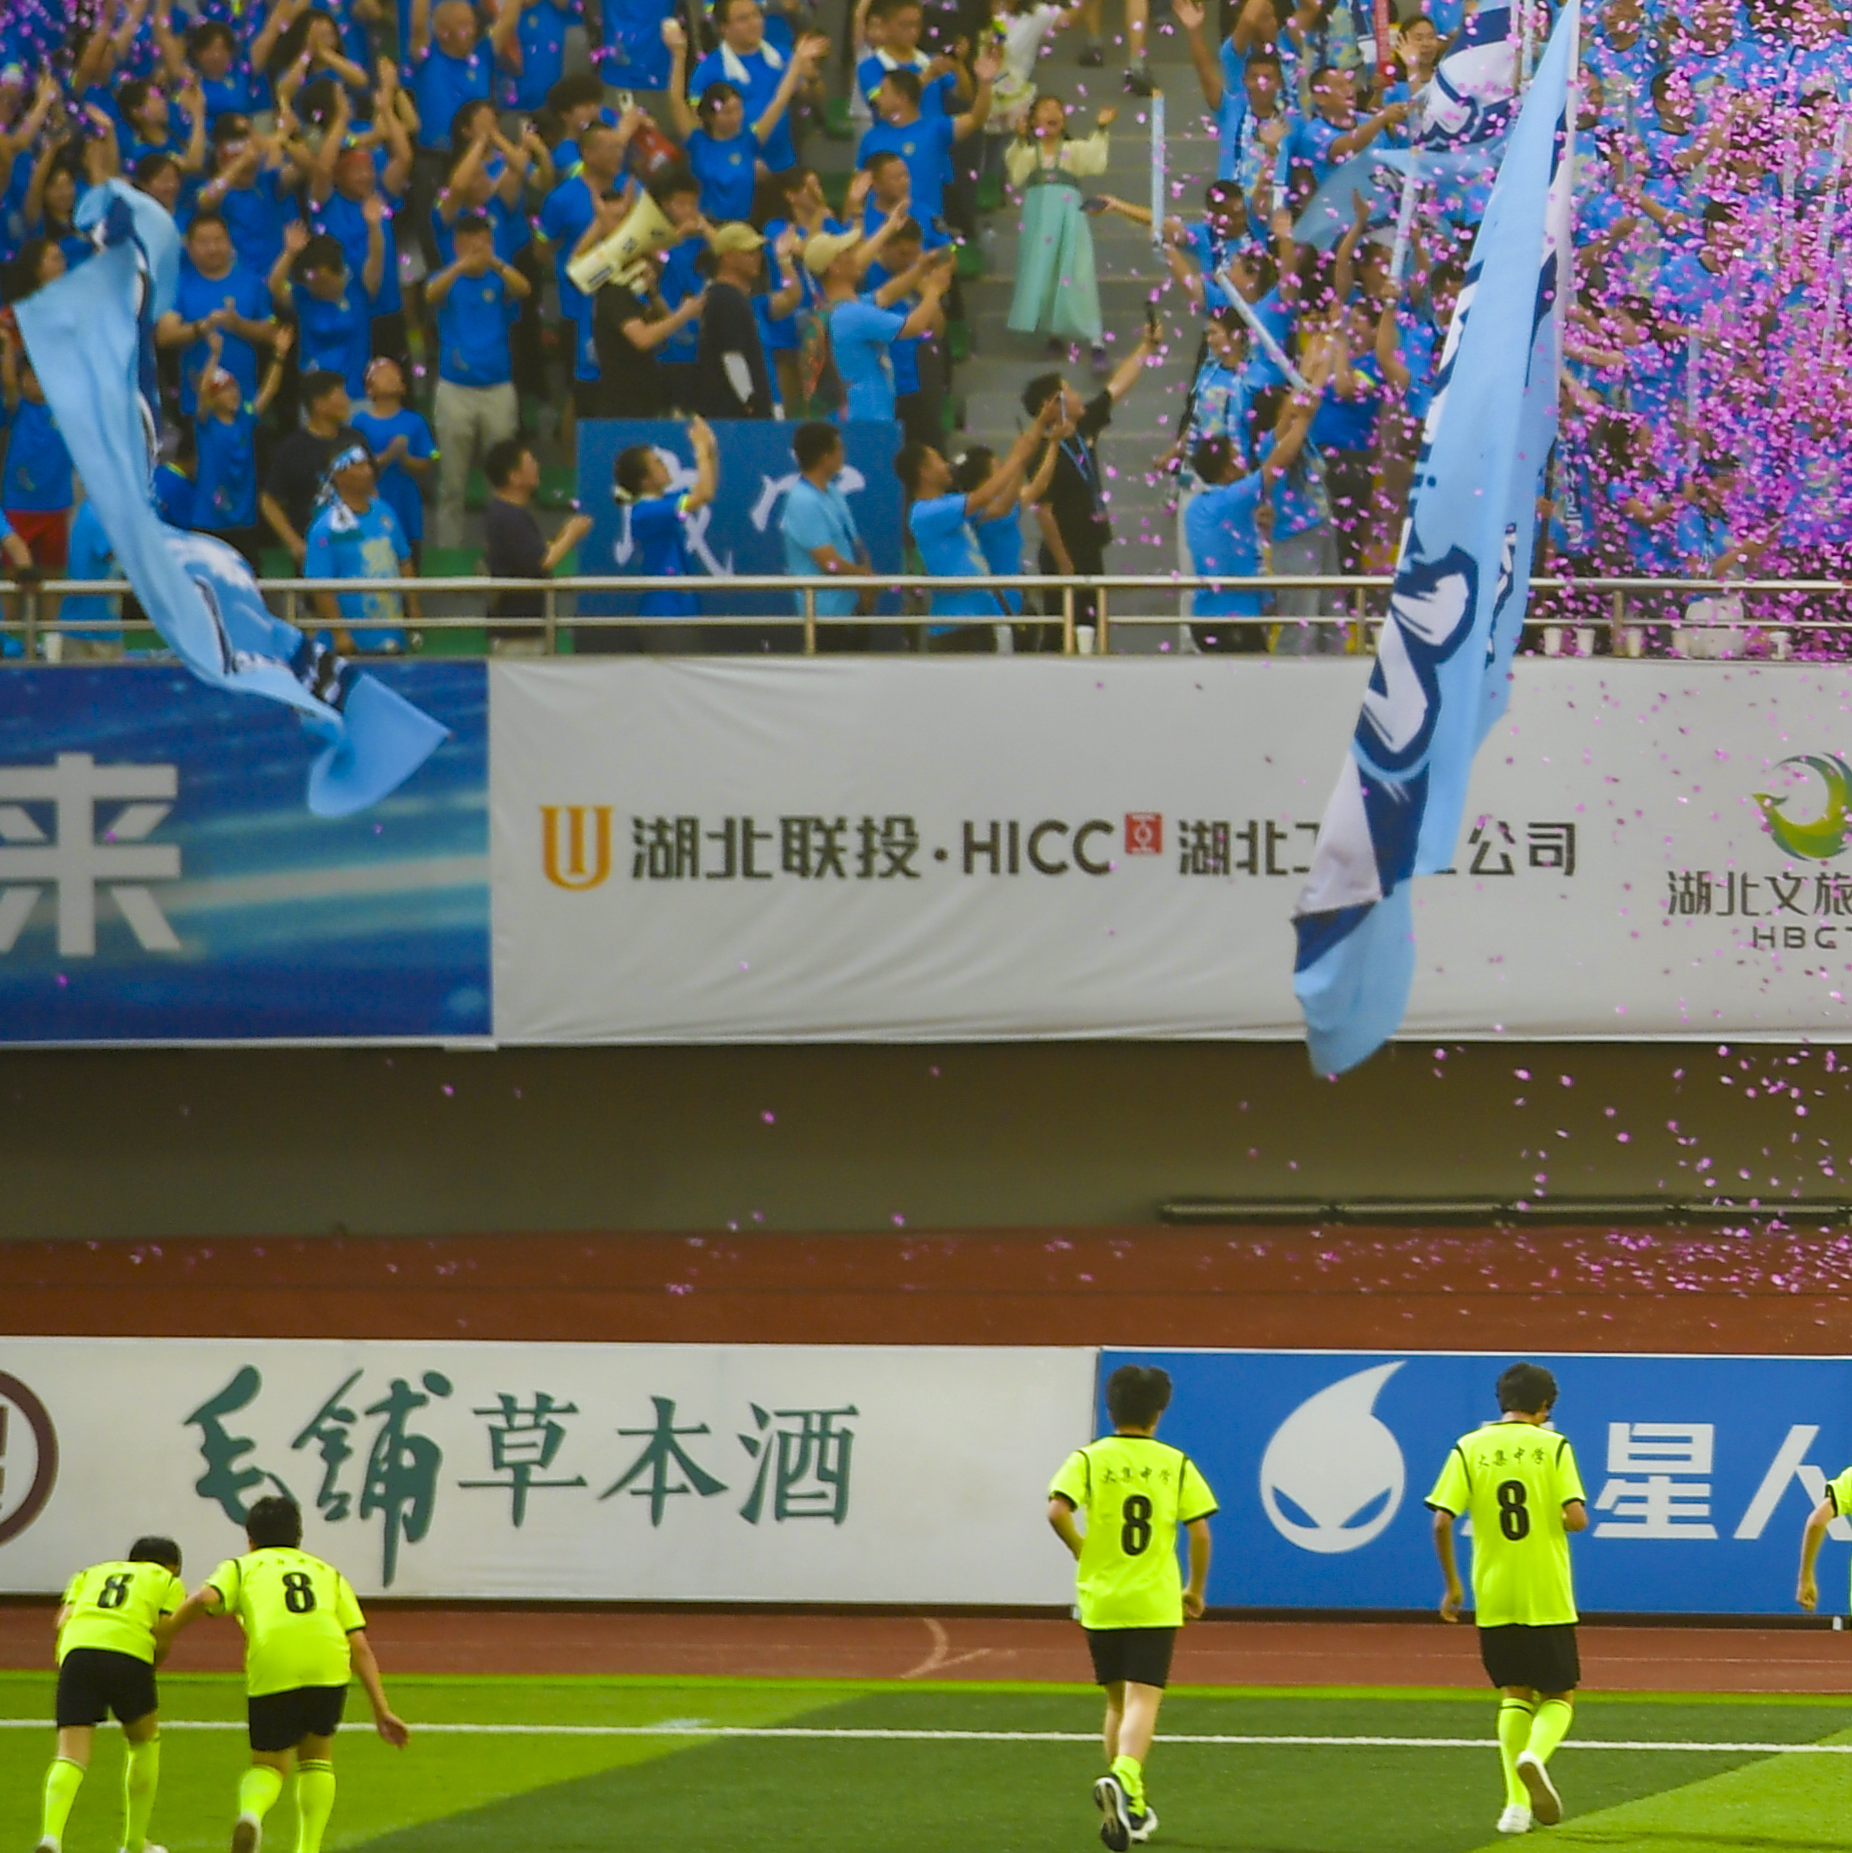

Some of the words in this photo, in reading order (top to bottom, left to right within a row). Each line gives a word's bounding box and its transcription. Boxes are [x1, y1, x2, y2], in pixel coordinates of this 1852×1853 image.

[1179, 819, 1576, 877] 湖北公司
[1121, 1493, 1153, 1557] 8
[1496, 1479, 1531, 1542] 8
[98, 1572, 136, 1609] 8
[282, 1571, 318, 1614] 8
